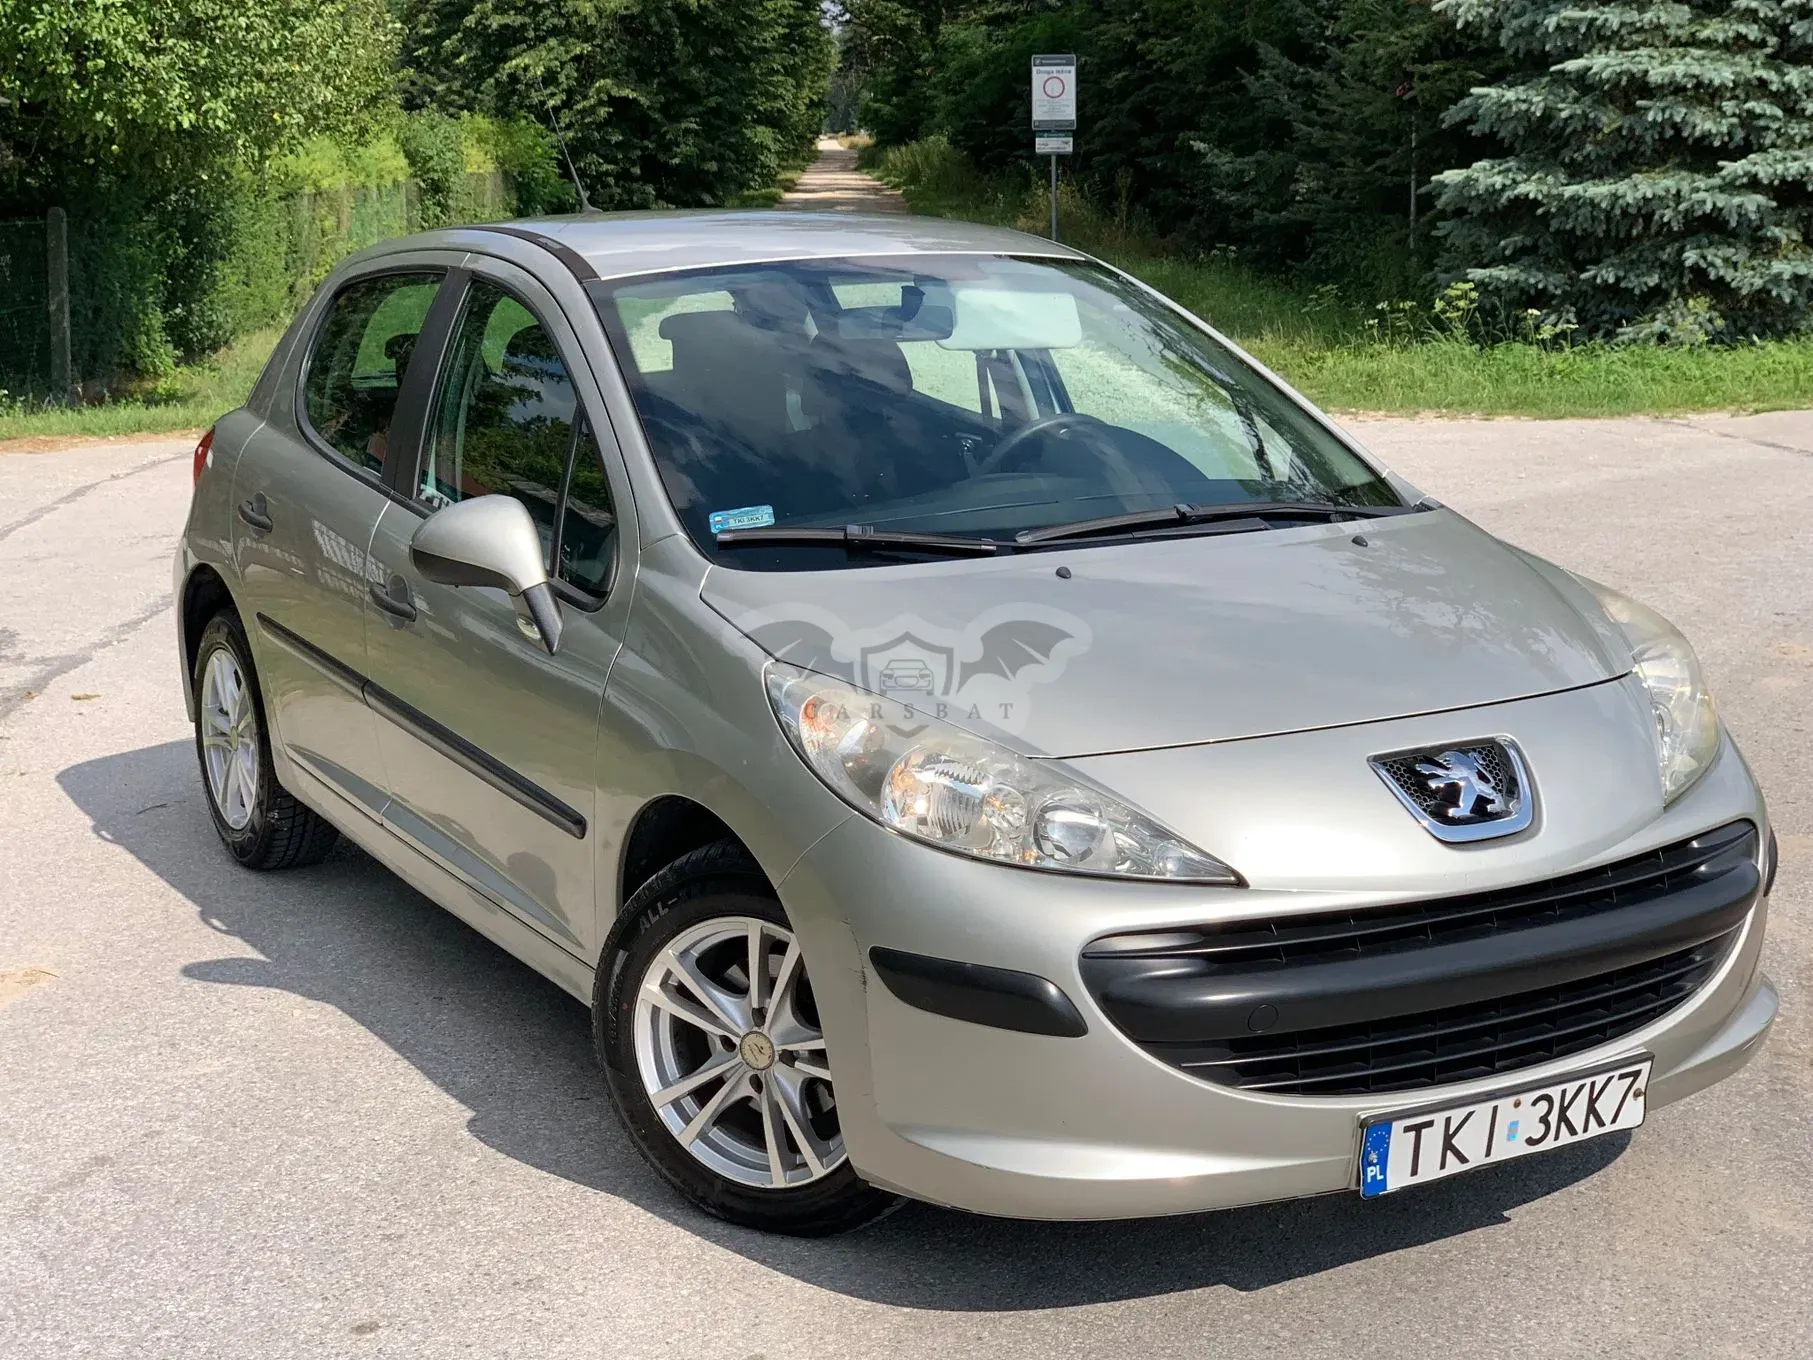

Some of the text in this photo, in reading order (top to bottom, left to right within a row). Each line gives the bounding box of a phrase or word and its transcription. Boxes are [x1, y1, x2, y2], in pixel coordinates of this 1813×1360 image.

[1367, 1069, 1642, 1183] PL TKI 3KK7
